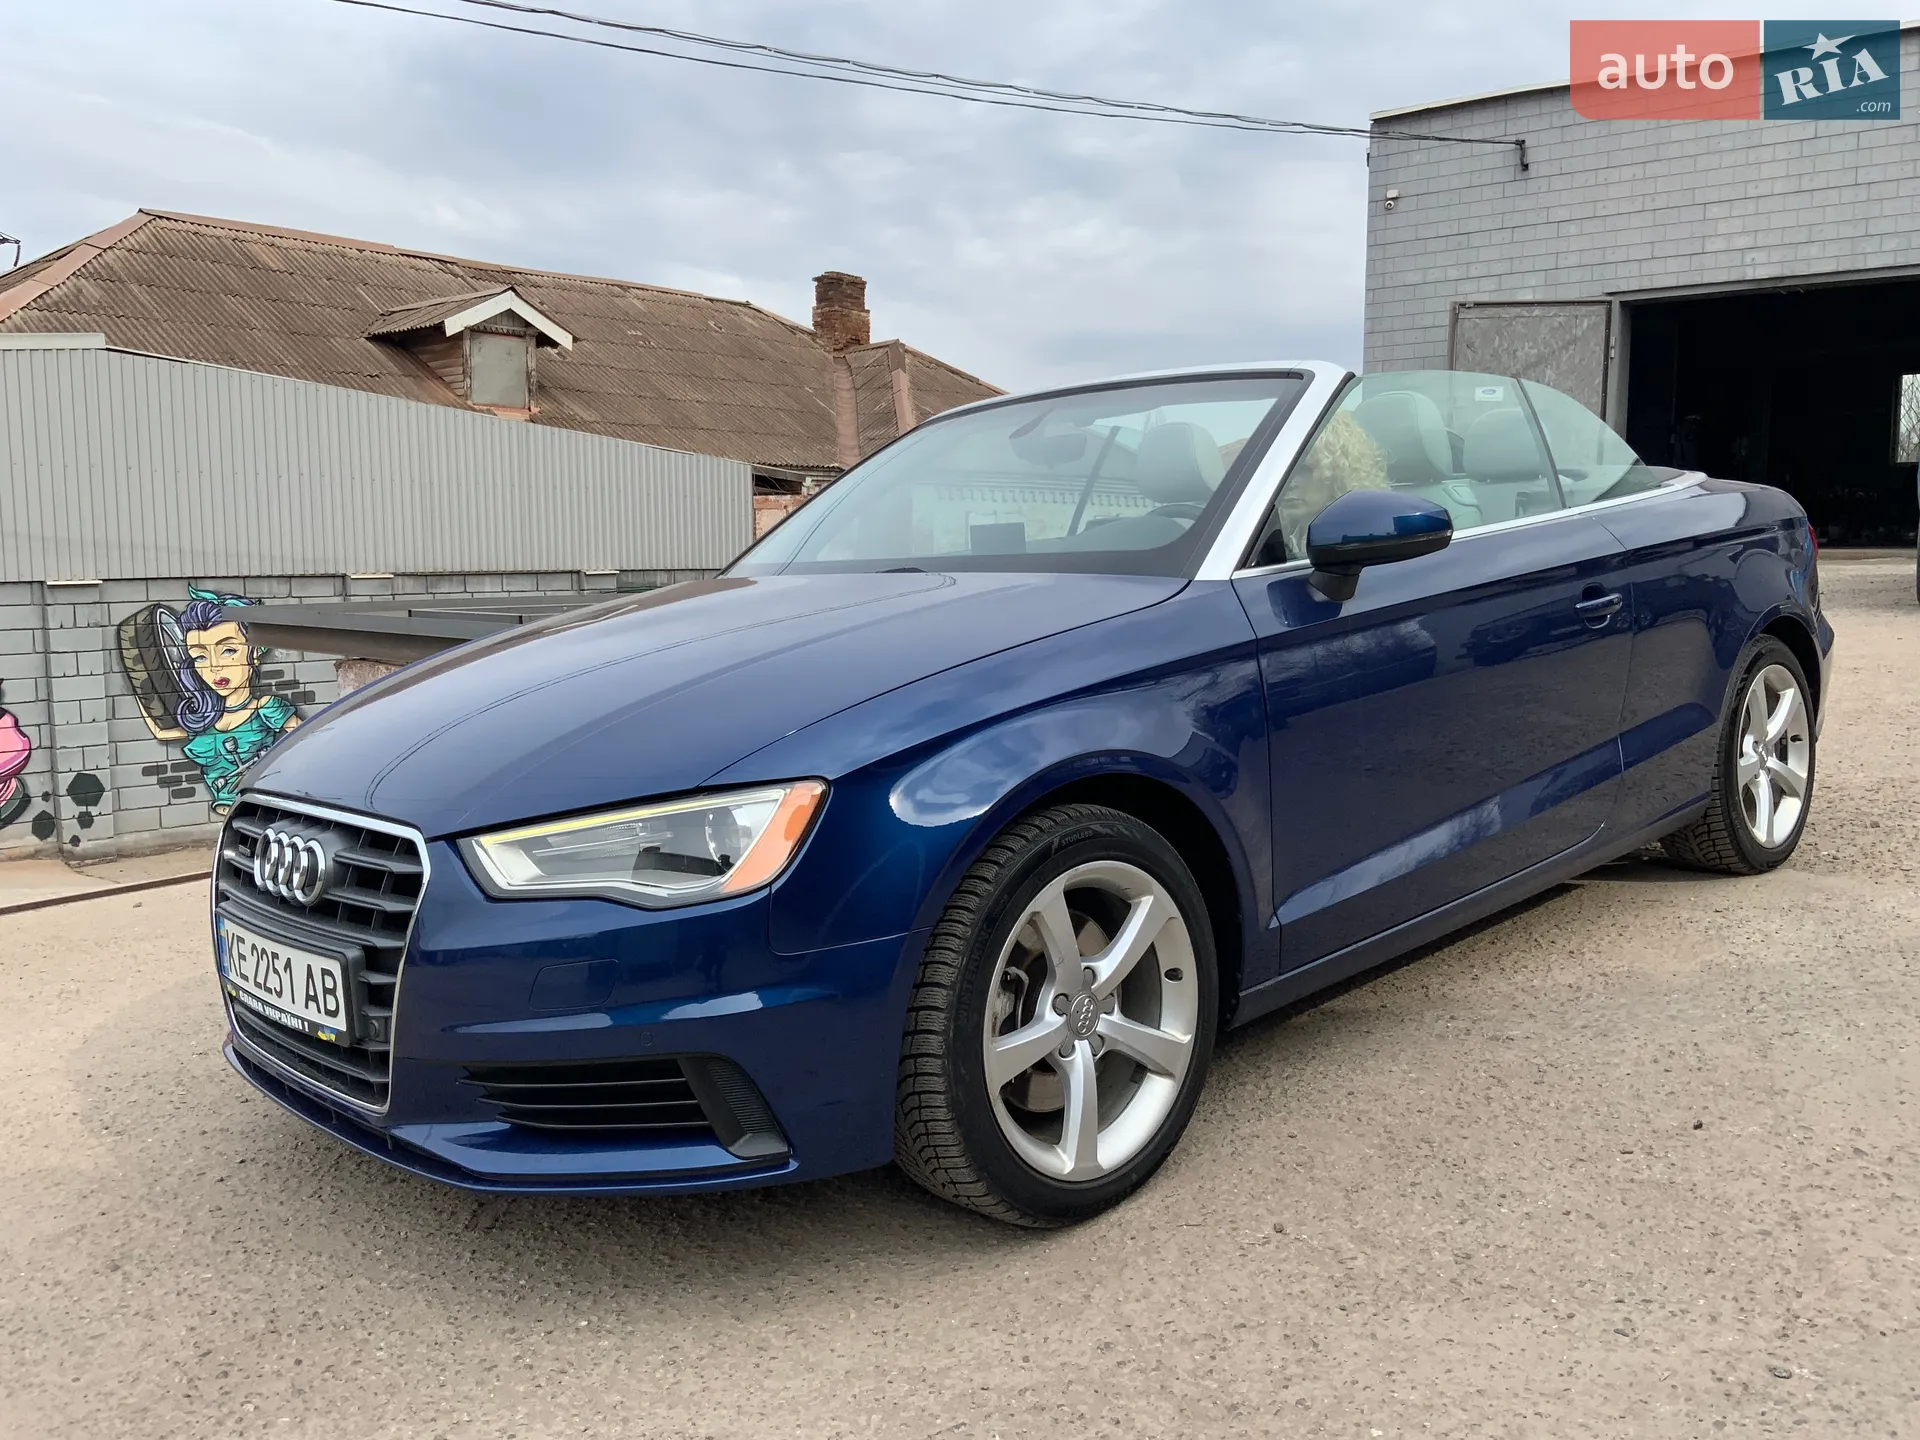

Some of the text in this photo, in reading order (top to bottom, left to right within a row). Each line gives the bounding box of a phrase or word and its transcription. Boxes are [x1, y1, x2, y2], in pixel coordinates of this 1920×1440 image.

[1060, 829, 1093, 847] STUDLESS
[225, 929, 340, 1019] KE 2251 AB
[239, 990, 264, 1013] СЛАВА
